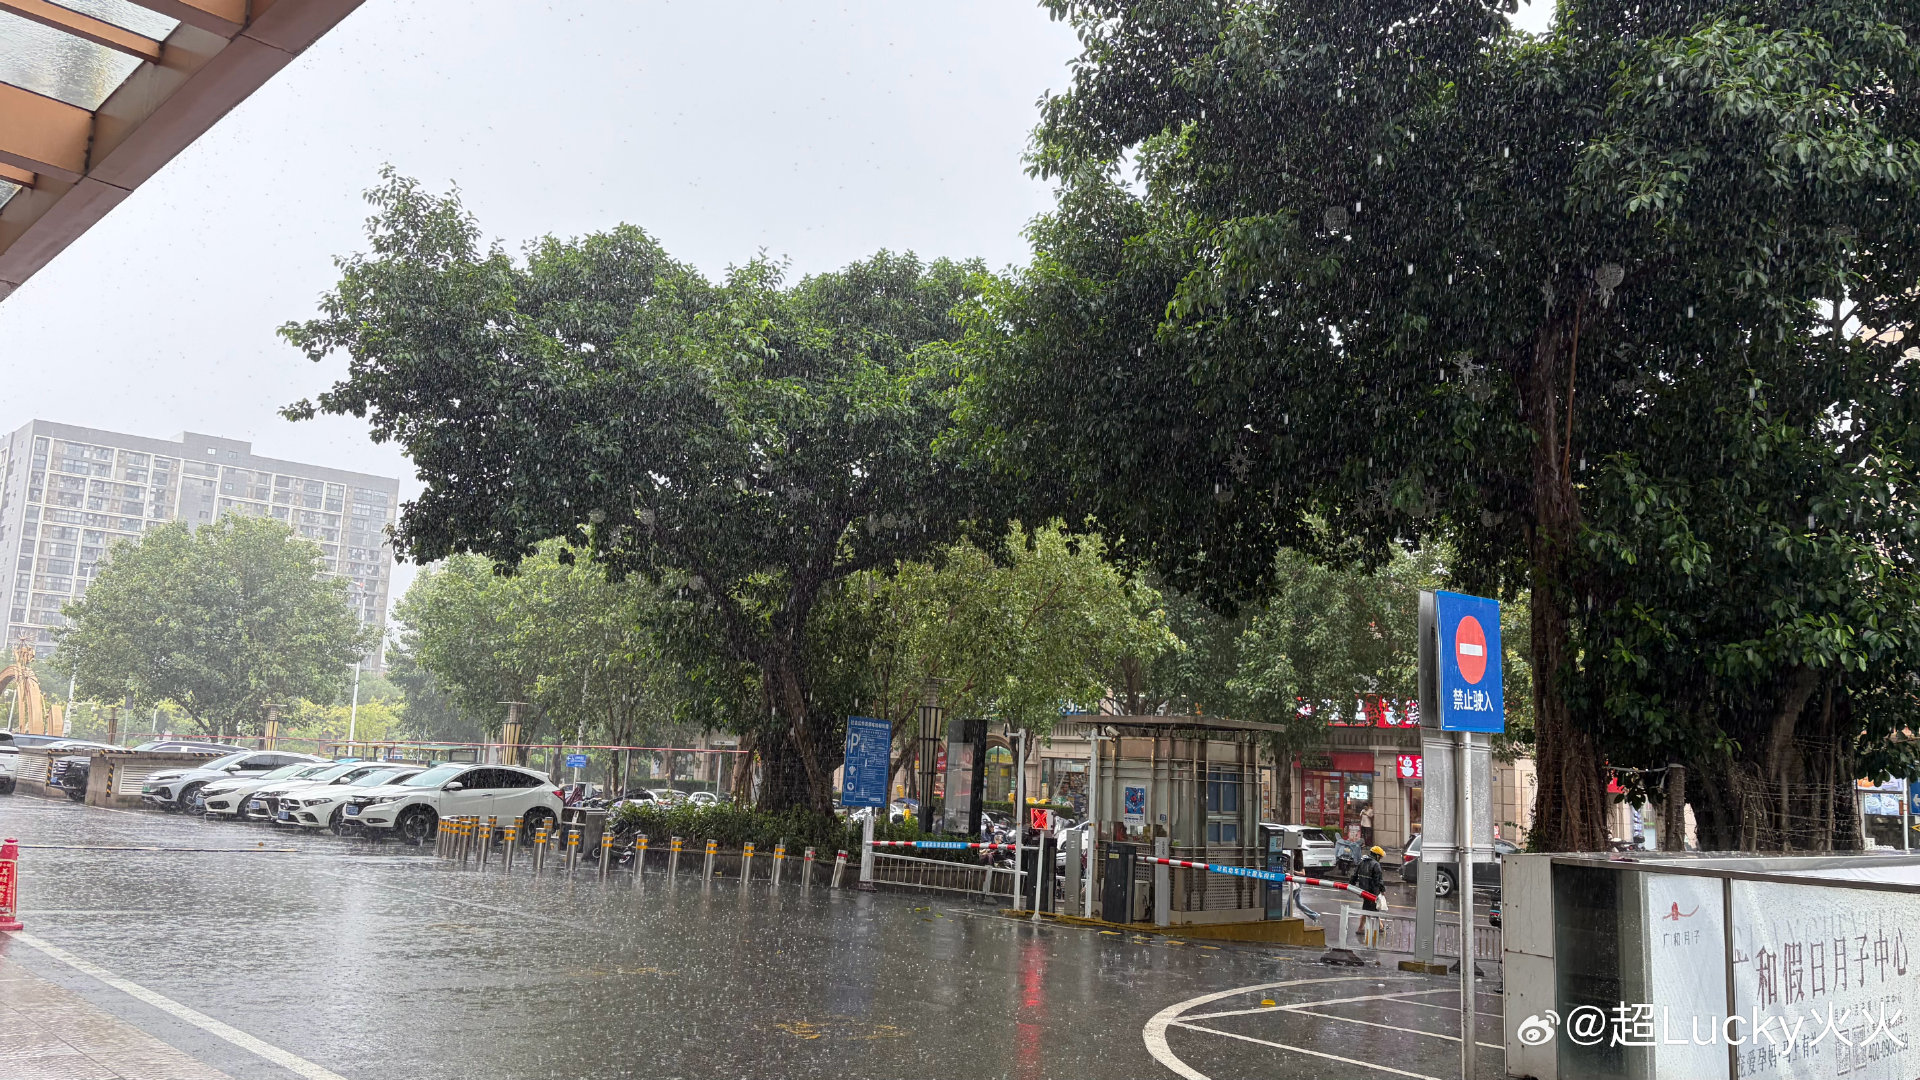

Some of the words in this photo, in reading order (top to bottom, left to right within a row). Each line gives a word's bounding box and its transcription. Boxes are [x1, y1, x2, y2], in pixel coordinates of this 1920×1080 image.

[1453, 688, 1494, 712] 禁止驶入
[1663, 930, 1700, 948] 广和月子
